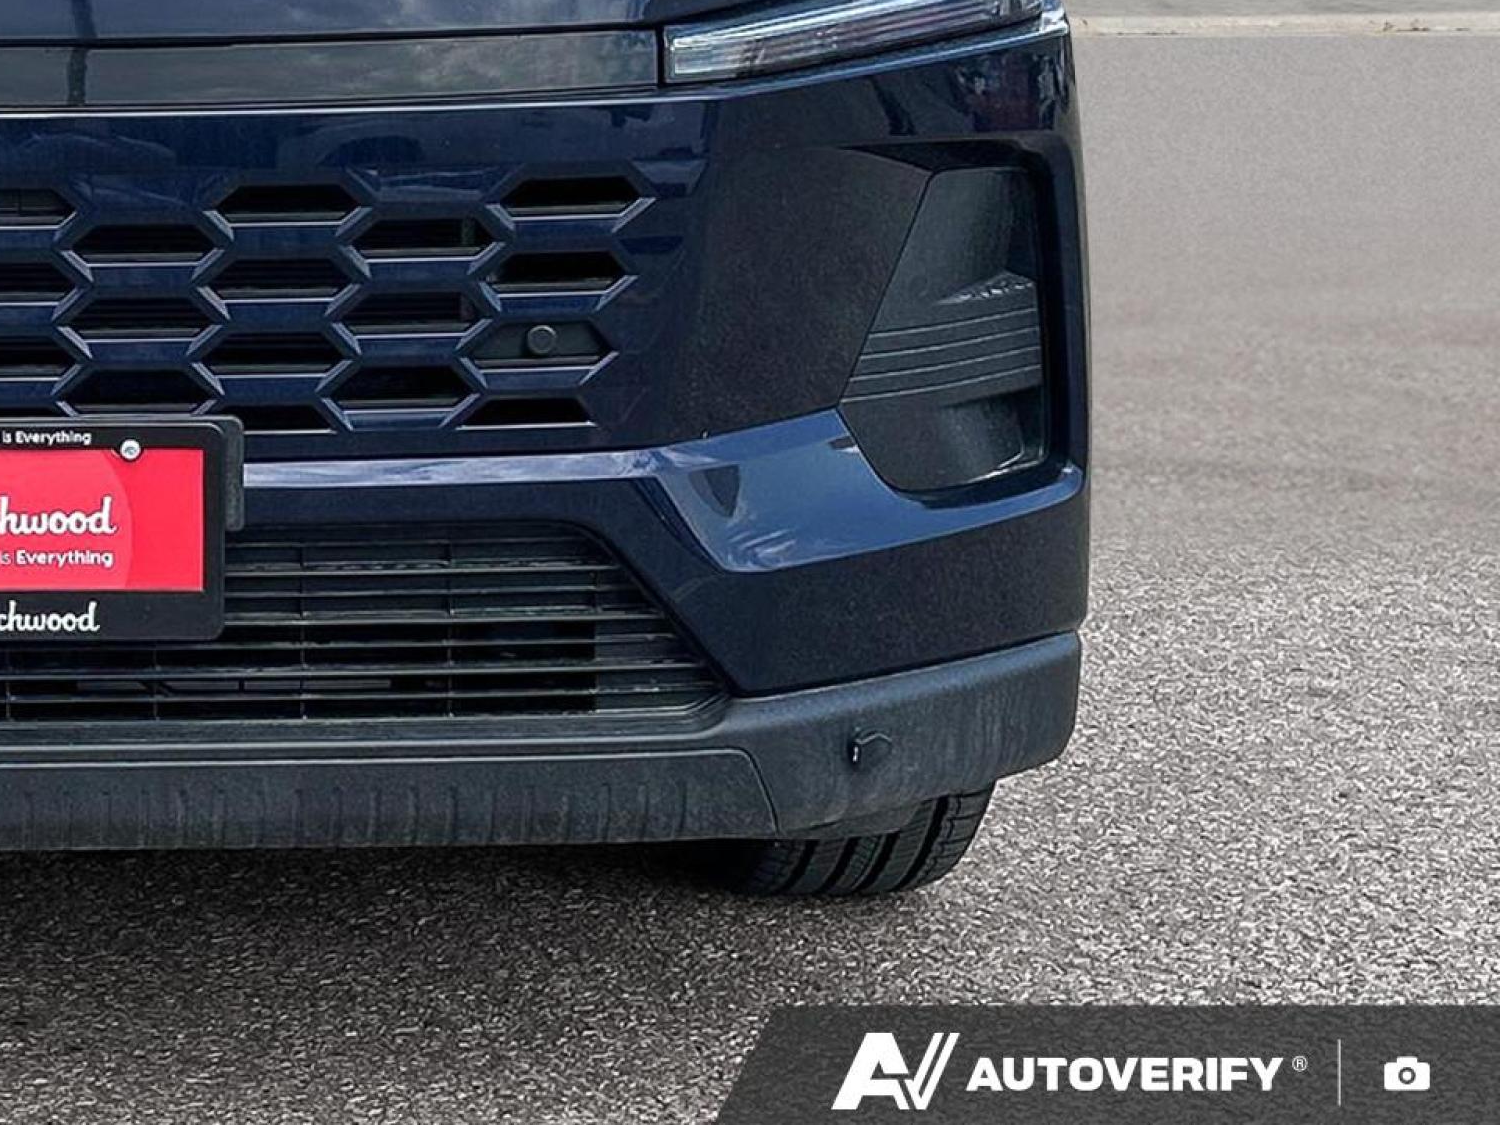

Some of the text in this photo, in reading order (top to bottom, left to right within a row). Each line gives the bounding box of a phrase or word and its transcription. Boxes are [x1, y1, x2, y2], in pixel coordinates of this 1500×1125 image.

[2, 430, 12, 444] is
[15, 430, 92, 446] Everything
[0, 551, 12, 565] is
[16, 549, 114, 568] Everything
